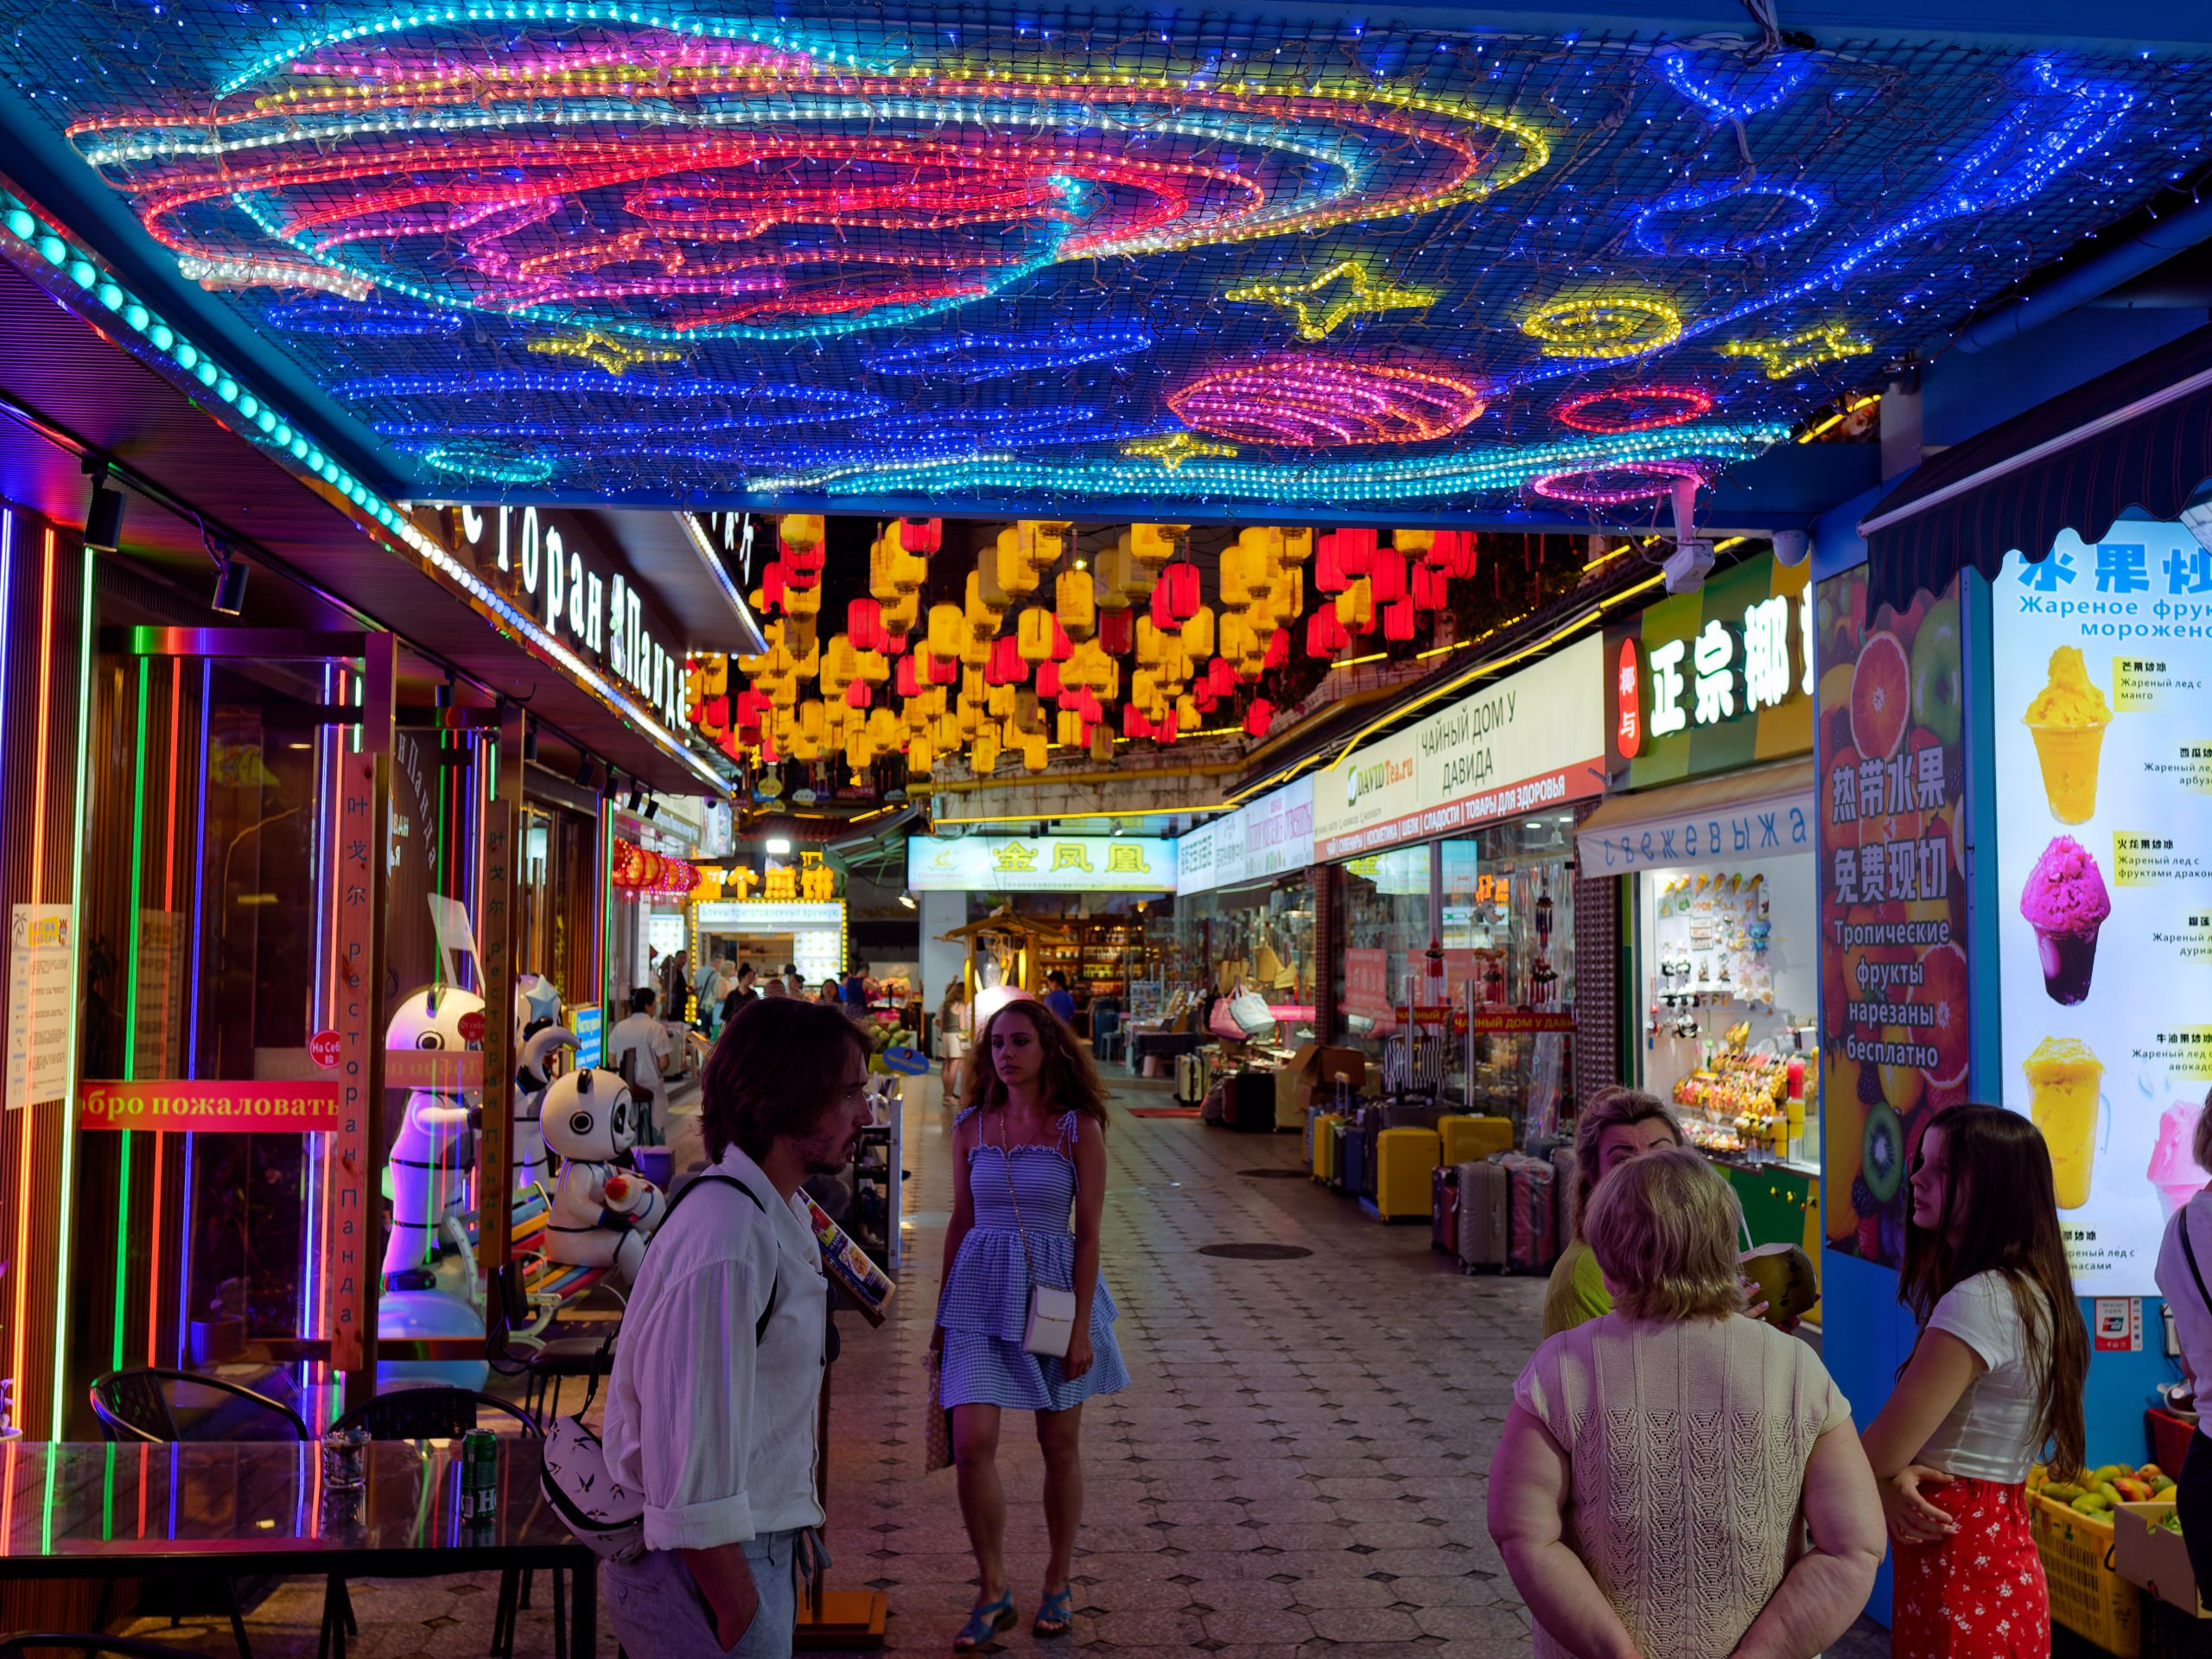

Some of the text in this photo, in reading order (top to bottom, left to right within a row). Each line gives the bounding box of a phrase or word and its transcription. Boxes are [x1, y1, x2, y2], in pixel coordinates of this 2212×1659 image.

[2018, 595, 2139, 618] Жареное
[626, 587, 685, 732] Панда
[2120, 677, 2171, 689] Жареный
[2175, 681, 2194, 690] лед
[1421, 690, 1516, 757] ЧАЙНЫЙ ДОМ У
[1442, 747, 1494, 798] ДАВИДА
[2144, 762, 2196, 774] Жареный
[2179, 775, 2212, 787] арбуз
[1833, 746, 1946, 824] 热带水果
[1402, 817, 1419, 836] ШЕЛК
[1424, 804, 1459, 832] СЛАДОСТИ
[1465, 797, 1497, 821] ТОВАРЫ
[1497, 791, 1516, 817] ДЛЯ
[1516, 774, 1566, 813] ЗДОРОВЬЯ
[993, 840, 1151, 874] 金凤凰
[1834, 836, 1947, 904] 免费现切
[2119, 855, 2170, 866] Жареный
[2172, 858, 2191, 867] лед
[2118, 868, 2171, 880] фруктами
[702, 907, 728, 917] Блины
[731, 907, 801, 918] приготовленные
[1834, 919, 1950, 951] Тропические
[2152, 932, 2204, 944] Жареный
[1857, 957, 1923, 990] фрукты
[487, 942, 501, 1108] ресторан
[1396, 1009, 1440, 1020] ЧАНЫЙ
[1455, 1015, 1503, 1028] ЧАНЫЙ
[1505, 1018, 1533, 1030] ДОМ
[1535, 1018, 1541, 1028] У
[1849, 1001, 1935, 1030] нарезаны
[312, 1041, 340, 1053] На Себ
[340, 796, 369, 1323] 叶戈尔 ресторан Панда
[1847, 1033, 1938, 1067] бесплатно
[2132, 1049, 2183, 1060] Жареный
[2187, 1051, 2206, 1059] лед
[151, 1096, 339, 1116] пожаловать
[485, 1128, 499, 1230] Панда
[2069, 1248, 2104, 1259] реный
